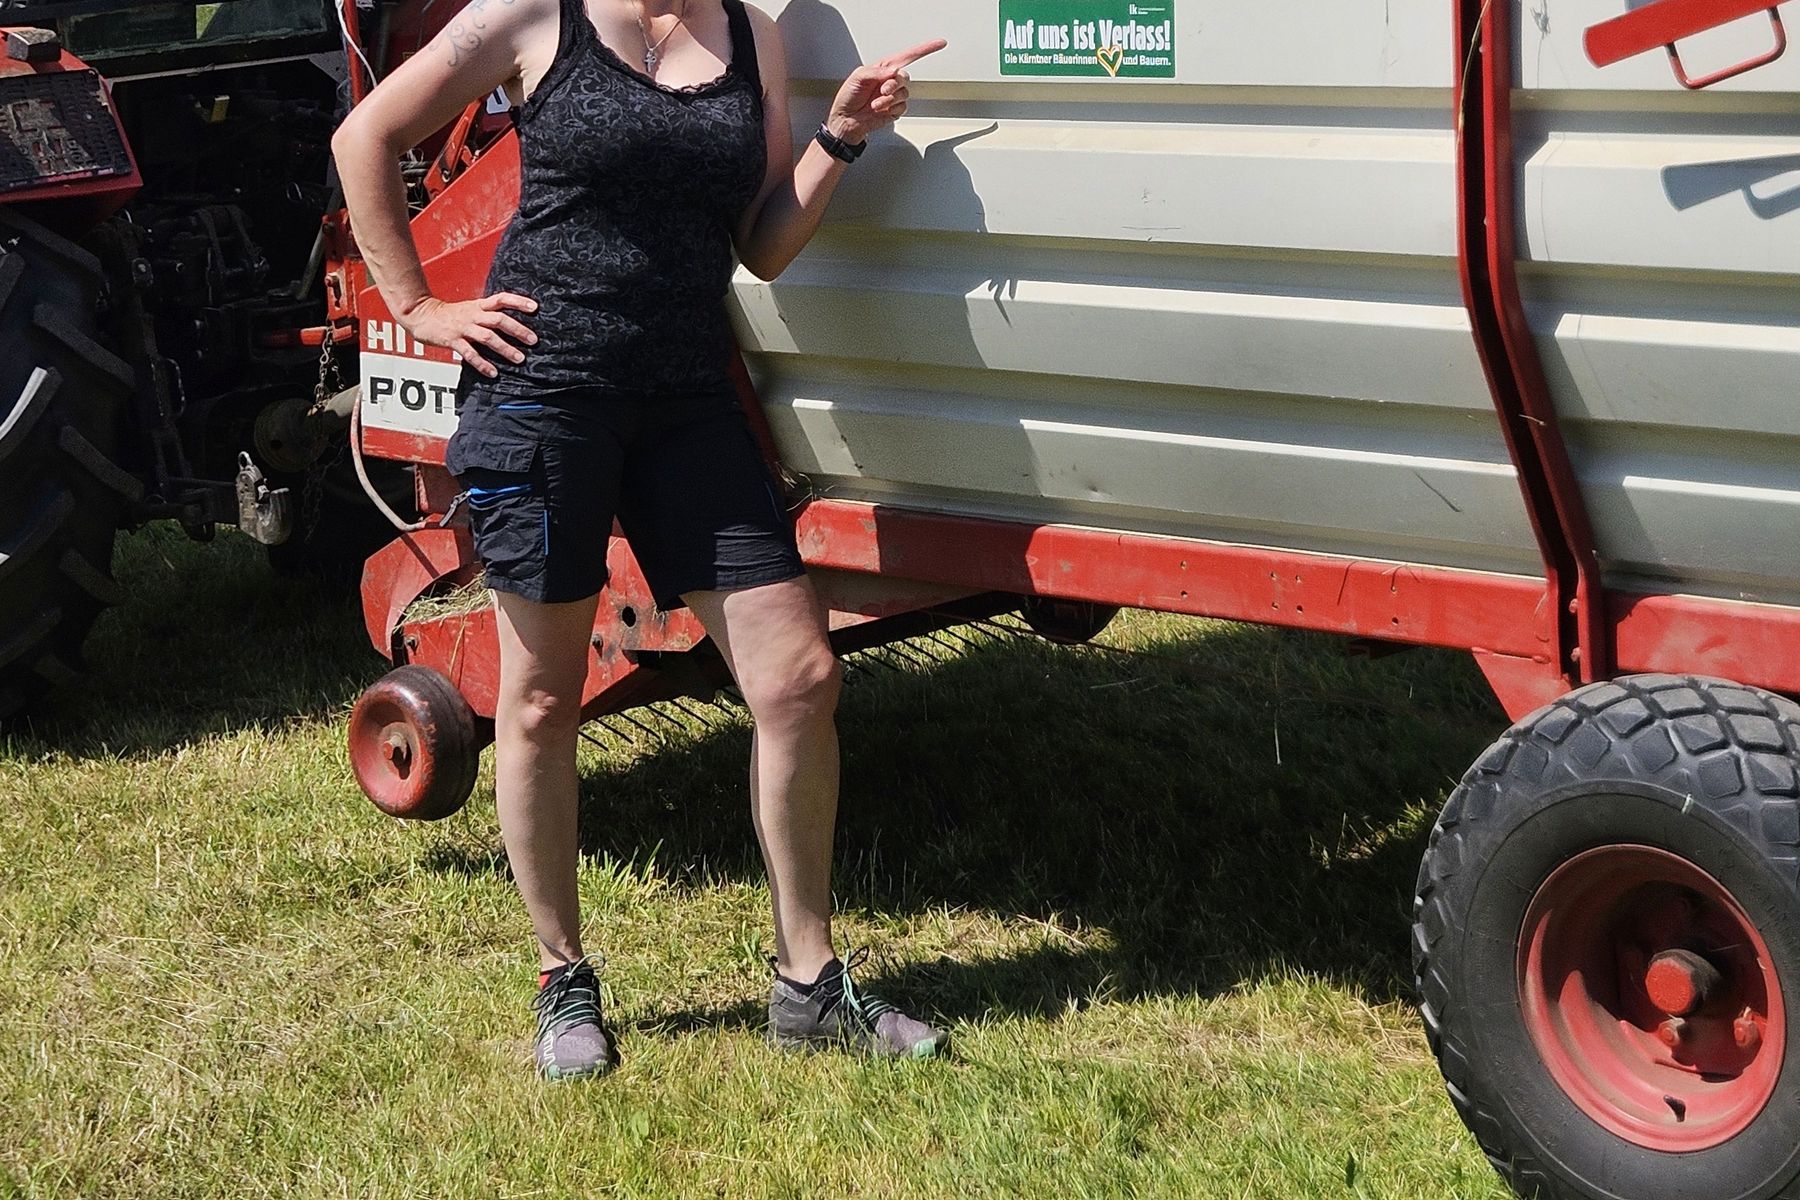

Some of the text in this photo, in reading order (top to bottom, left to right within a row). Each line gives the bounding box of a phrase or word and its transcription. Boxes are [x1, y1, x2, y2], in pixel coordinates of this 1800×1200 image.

[1004, 19, 1171, 51] Auf uns ist Verlass!
[1004, 53, 1172, 66] Die Kärntner Bäuerinnen und Bauern.
